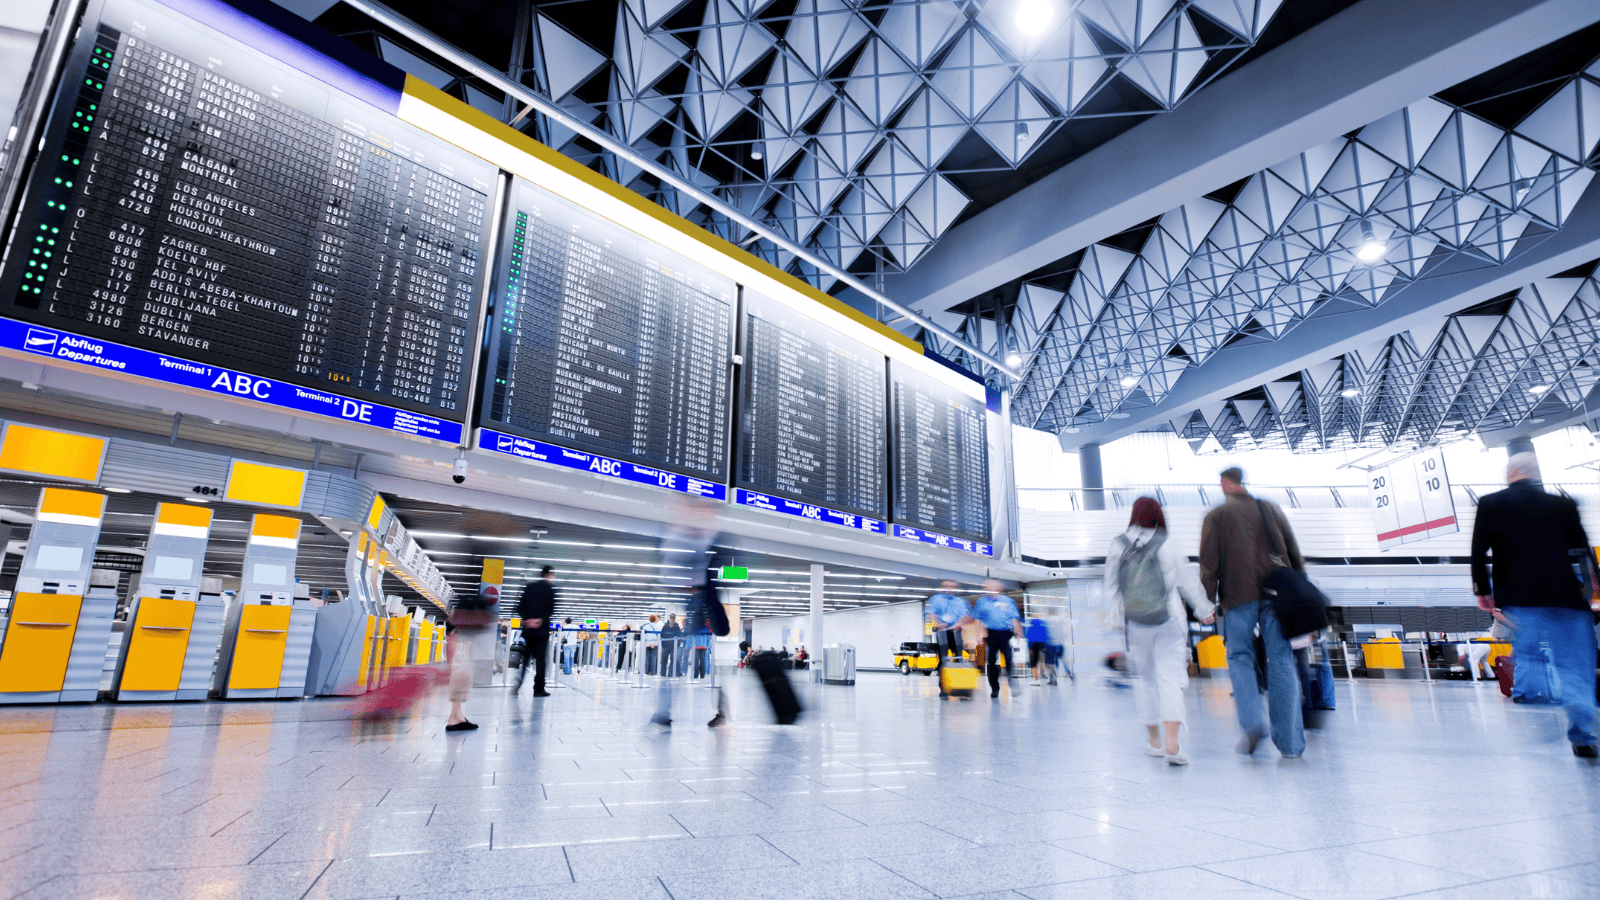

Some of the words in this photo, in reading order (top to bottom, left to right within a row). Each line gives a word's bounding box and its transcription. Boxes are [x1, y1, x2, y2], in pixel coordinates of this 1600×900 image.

[156, 61, 187, 81] 3102
[201, 81, 257, 111] HELSINKI
[159, 51, 190, 71] 2188
[203, 71, 260, 102] VARADERO
[145, 101, 177, 120] 3236
[158, 84, 182, 100] 462
[196, 100, 232, 122] MIAMI
[161, 74, 185, 91] 468
[198, 90, 255, 121] PORTLAND
[141, 146, 166, 161] 875
[180, 160, 239, 189] MONTREAL
[144, 135, 168, 151] 494
[183, 150, 235, 176] CALGARY
[129, 189, 154, 204] 440
[169, 202, 223, 227] HOUSTON
[132, 178, 157, 193] 442
[172, 192, 225, 216] DETROIT
[135, 167, 160, 182] 456
[175, 181, 198, 196] LOS
[205, 192, 255, 216] ANGELES
[118, 197, 151, 215] 4726
[166, 213, 276, 255] LONDON-HEATHROW
[120, 222, 146, 237] 417
[161, 234, 208, 256] ZAGREB
[108, 230, 143, 248] 6808
[158, 245, 198, 264] KOELN
[204, 259, 227, 273] HBF
[114, 244, 140, 259] 686
[155, 256, 180, 271] TEL
[186, 266, 217, 282] AVIV
[104, 279, 131, 293] 117
[146, 290, 217, 316] LJUBLJANA
[107, 267, 134, 282] 176
[149, 279, 241, 311] BERLIN-TEGEL
[110, 256, 137, 270] 590
[152, 268, 192, 286] ADDIS
[199, 281, 298, 316] ABEBA-KHARTOUM
[88, 300, 124, 317] 3126
[140, 313, 189, 333] BERGEN
[92, 288, 127, 305] 4980
[143, 302, 192, 322] DUBLIN
[60, 336, 103, 354] Abflug
[85, 312, 121, 329] 3160
[137, 325, 209, 350] STAVANGER
[559, 335, 588, 351] CHICAGO
[57, 347, 126, 369] Departures
[558, 343, 587, 359] DETROIT
[159, 357, 205, 375] Terminal
[206, 368, 212, 376] 1
[211, 371, 272, 399] ABC
[295, 388, 333, 404] Terminal
[332, 397, 340, 405] 2
[341, 399, 374, 422] DE
[553, 392, 582, 407] TORONTO
[554, 384, 583, 399] VILNIUS
[552, 401, 585, 416] HELSINKI
[514, 439, 535, 450] Abflug
[549, 426, 575, 439] DUBLIN
[550, 418, 599, 437] POZNAN/POSEN
[513, 447, 547, 460] Departures
[562, 450, 585, 461] Terminal
[589, 457, 621, 477] ABC
[633, 465, 653, 476] Terminal
[658, 471, 676, 488] DE
[192, 485, 218, 496] 464
[1372, 475, 1386, 490] 20
[1421, 457, 1436, 472] 10
[1375, 494, 1389, 508] 20
[1425, 477, 1440, 492] 10
[801, 505, 821, 520] ABC
[843, 514, 855, 527] DE
[935, 535, 949, 546] ABC
[963, 541, 972, 551] DE
